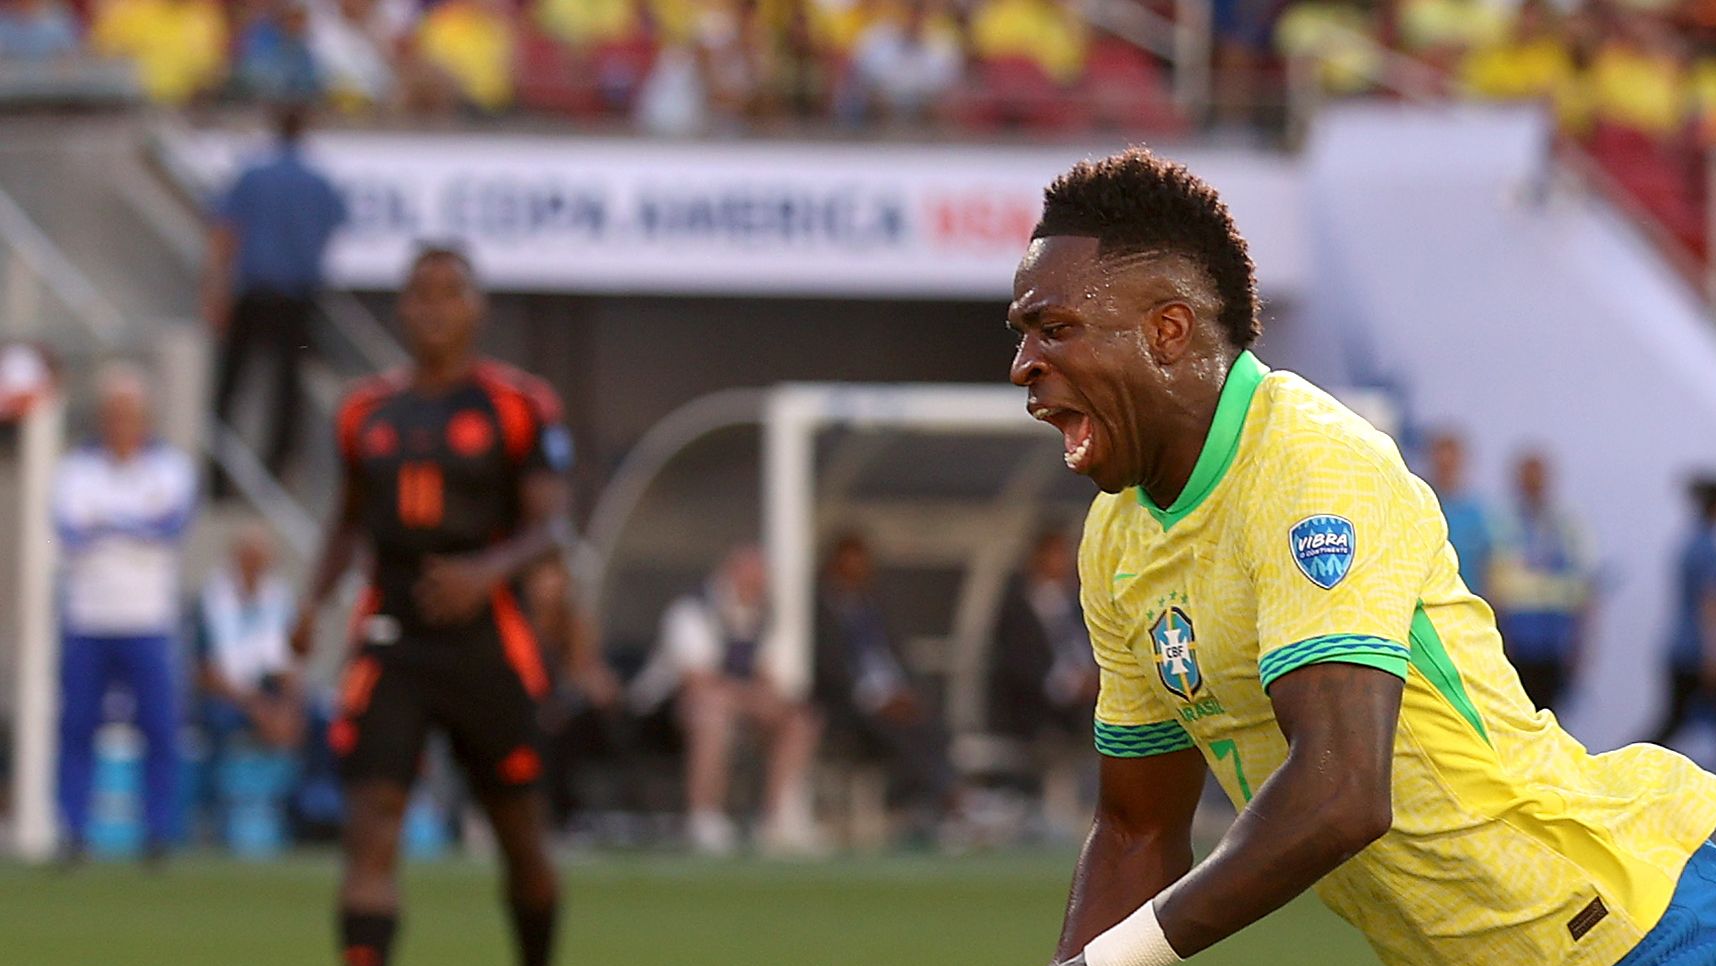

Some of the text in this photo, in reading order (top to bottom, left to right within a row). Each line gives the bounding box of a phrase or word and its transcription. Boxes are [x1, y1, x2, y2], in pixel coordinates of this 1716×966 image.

[449, 182, 606, 242] COPA
[634, 184, 908, 242] AMERICA
[1298, 532, 1348, 552] VIBRA
[1166, 645, 1184, 659] CBF
[1208, 738, 1253, 802] 7
